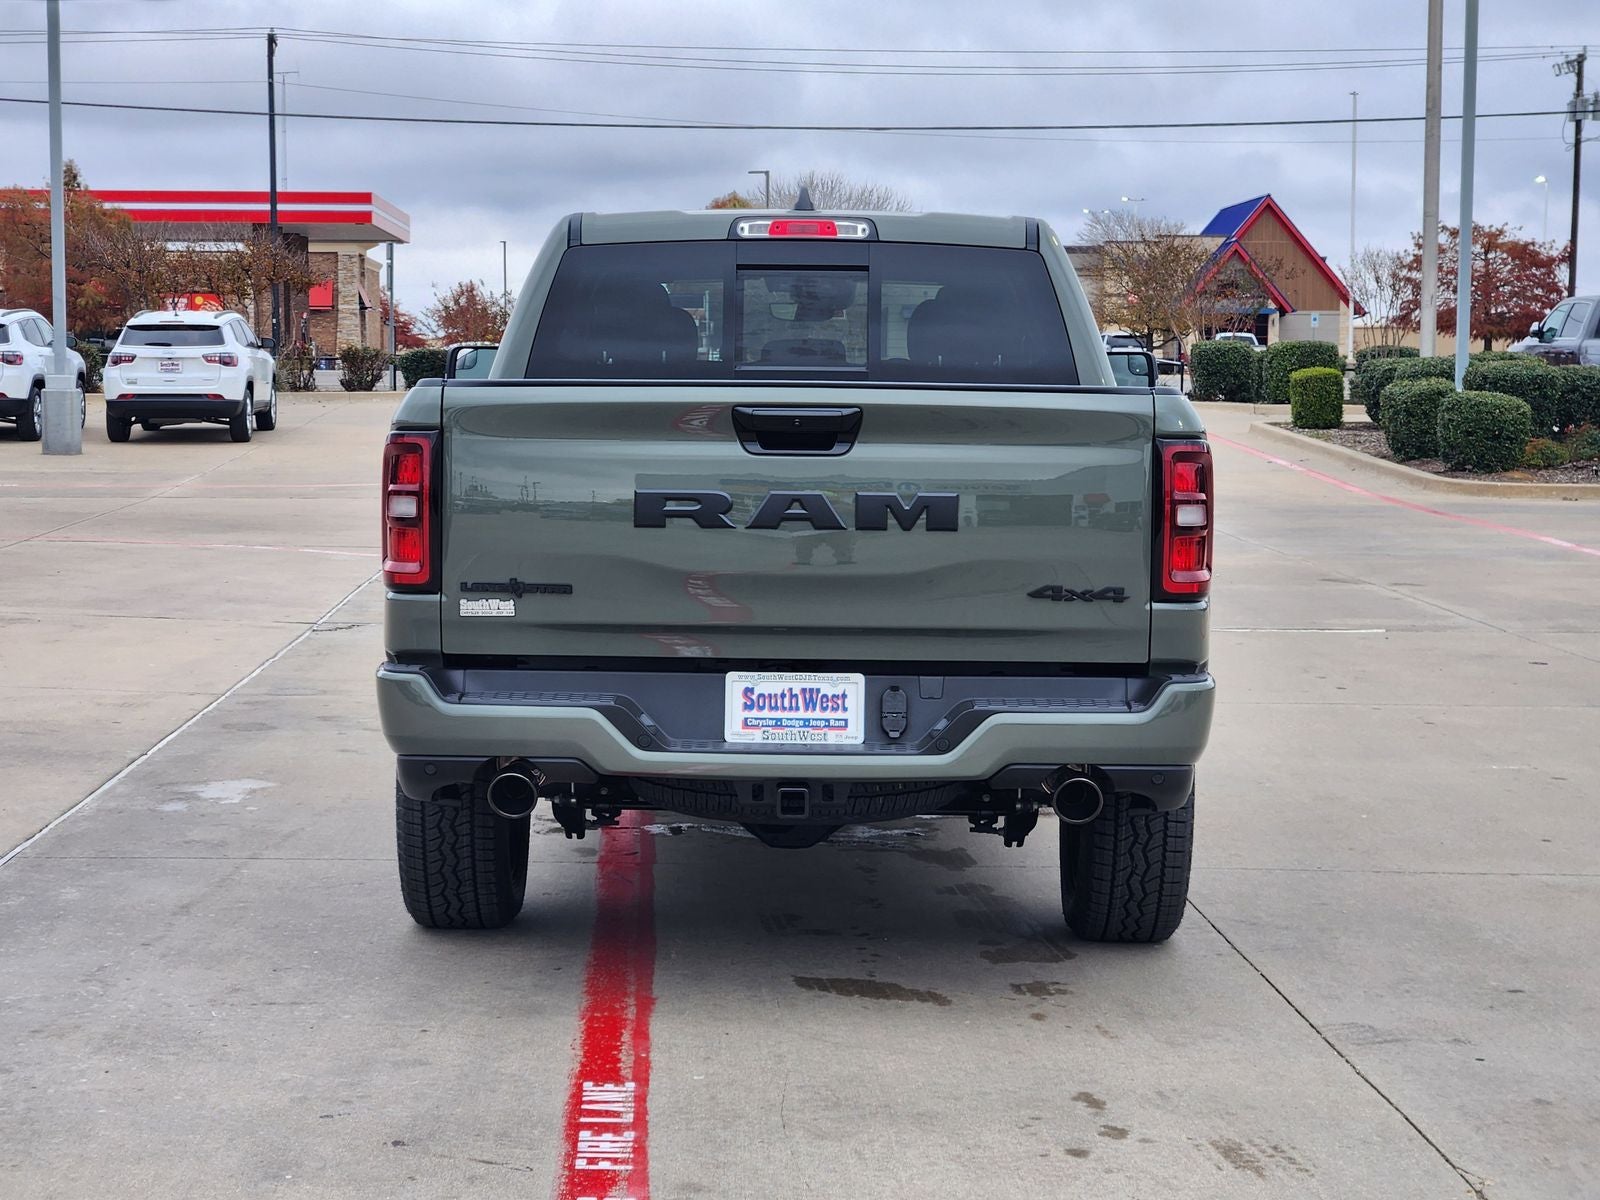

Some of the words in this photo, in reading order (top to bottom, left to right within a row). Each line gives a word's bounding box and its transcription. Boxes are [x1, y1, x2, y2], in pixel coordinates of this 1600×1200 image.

[634, 489, 959, 531] RAM
[1027, 584, 1130, 603] 4x4
[742, 686, 848, 713] SouthWest
[747, 719, 776, 727] Chrysler
[782, 719, 804, 728] Dodge
[809, 719, 826, 728] Jeep
[830, 719, 846, 727] Ram
[762, 730, 828, 741] SouthWest
[579, 1081, 635, 1123] LANE
[575, 1131, 634, 1170] FIRE
